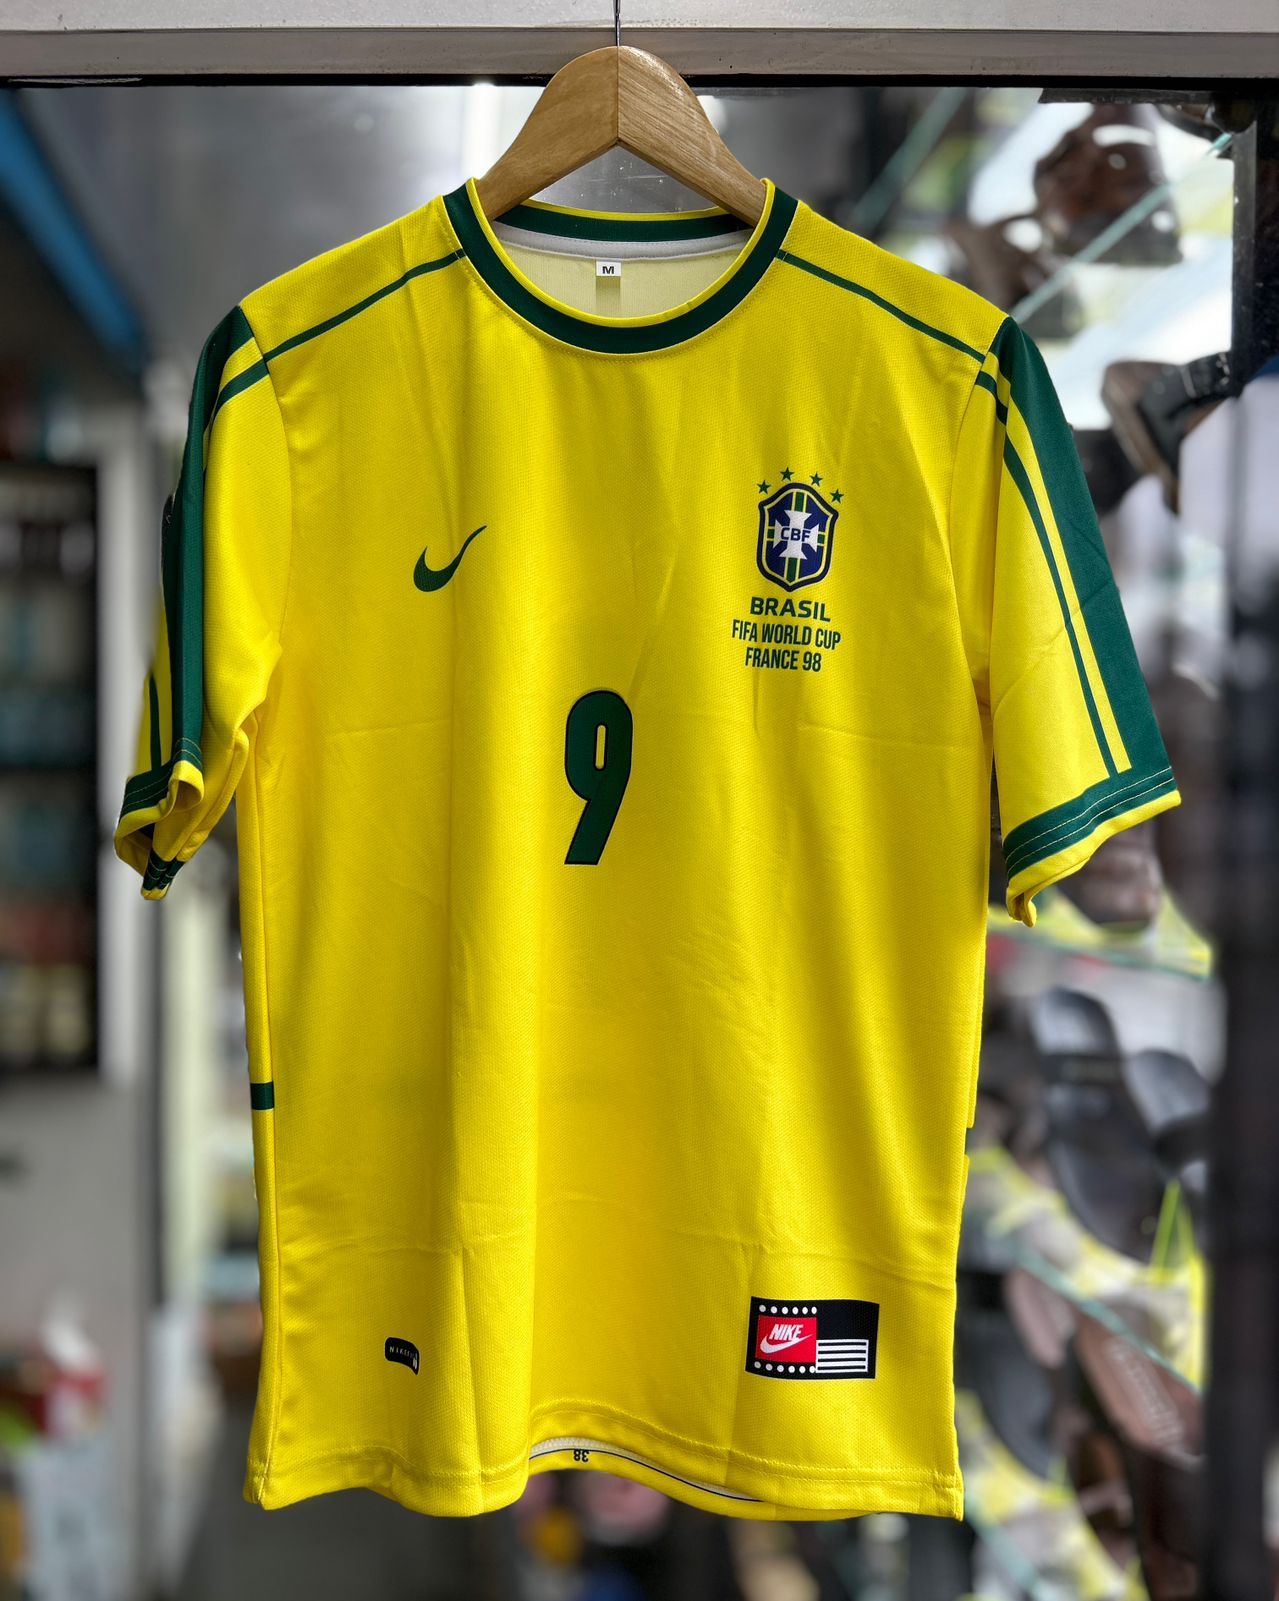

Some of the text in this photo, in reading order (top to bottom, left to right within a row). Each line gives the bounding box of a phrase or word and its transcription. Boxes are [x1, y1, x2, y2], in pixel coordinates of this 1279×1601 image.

[602, 265, 615, 275] M
[780, 526, 811, 543] CBF
[750, 596, 831, 622] BRASIL
[732, 619, 841, 650] FIFA WORLD CUP
[745, 646, 822, 672] FRANCE 98
[564, 689, 633, 866] 9
[769, 1323, 804, 1341] NIKE
[573, 1449, 590, 1463] 38
